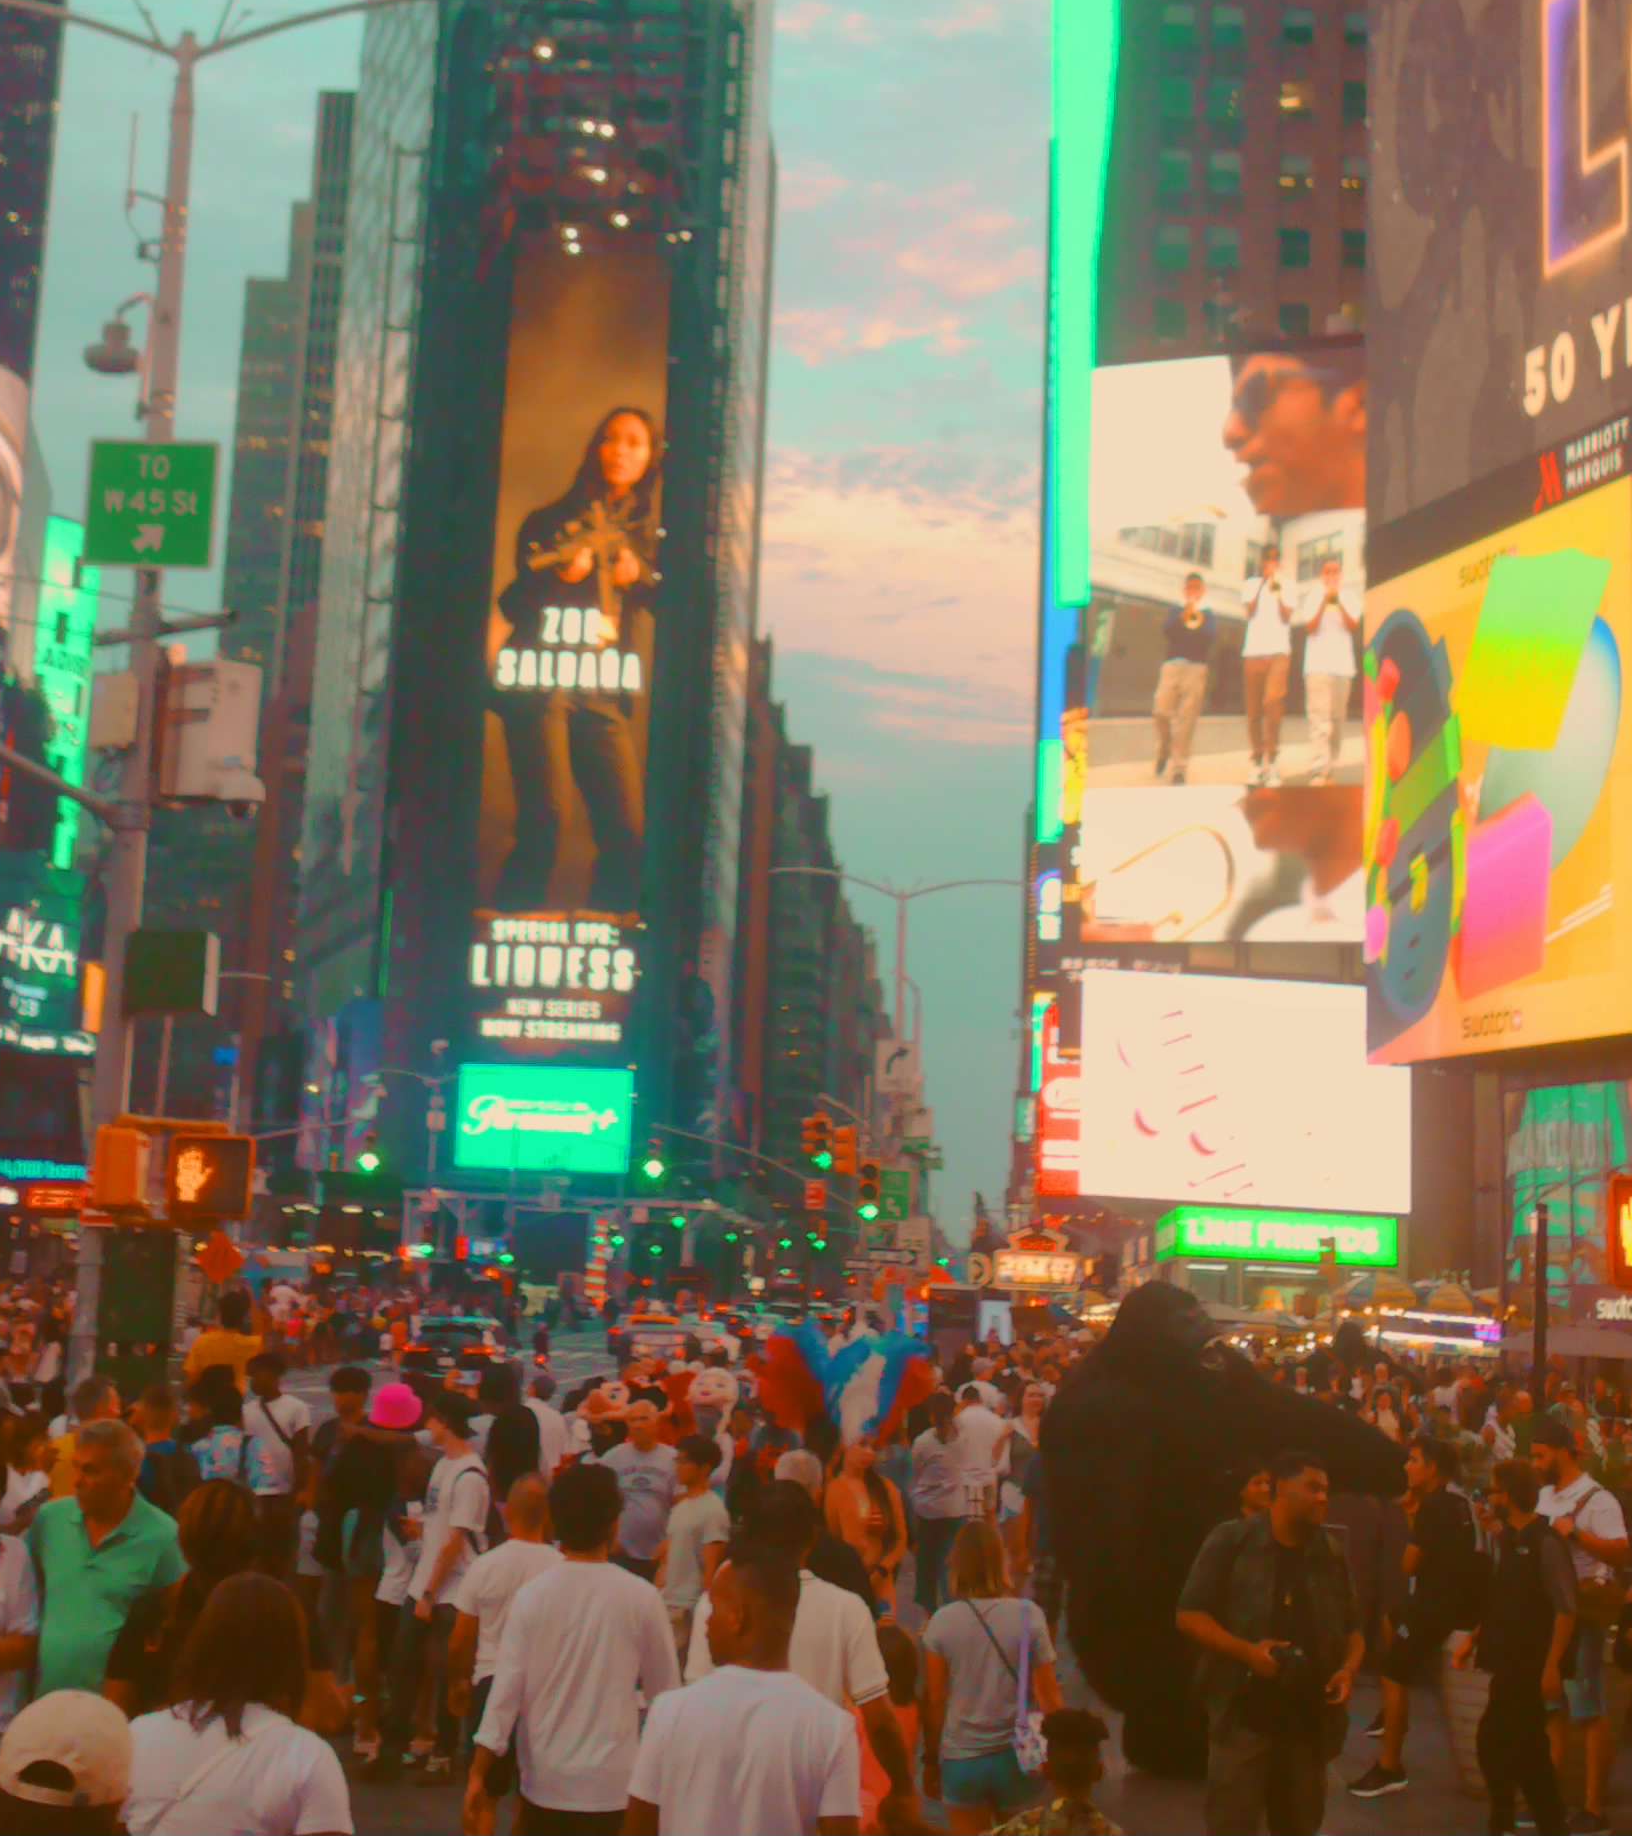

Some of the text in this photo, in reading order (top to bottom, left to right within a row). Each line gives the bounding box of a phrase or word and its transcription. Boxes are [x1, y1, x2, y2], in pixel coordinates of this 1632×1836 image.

[1522, 330, 1578, 419] 50
[138, 453, 171, 480] TO
[103, 488, 125, 514] W
[129, 489, 166, 515] 45
[491, 919, 570, 944] SPECIAL
[471, 943, 635, 991] LIONESS
[505, 998, 603, 1020] NEW SERIES
[480, 1018, 622, 1042] NOW STREAMING
[1187, 1217, 1252, 1247] LINE
